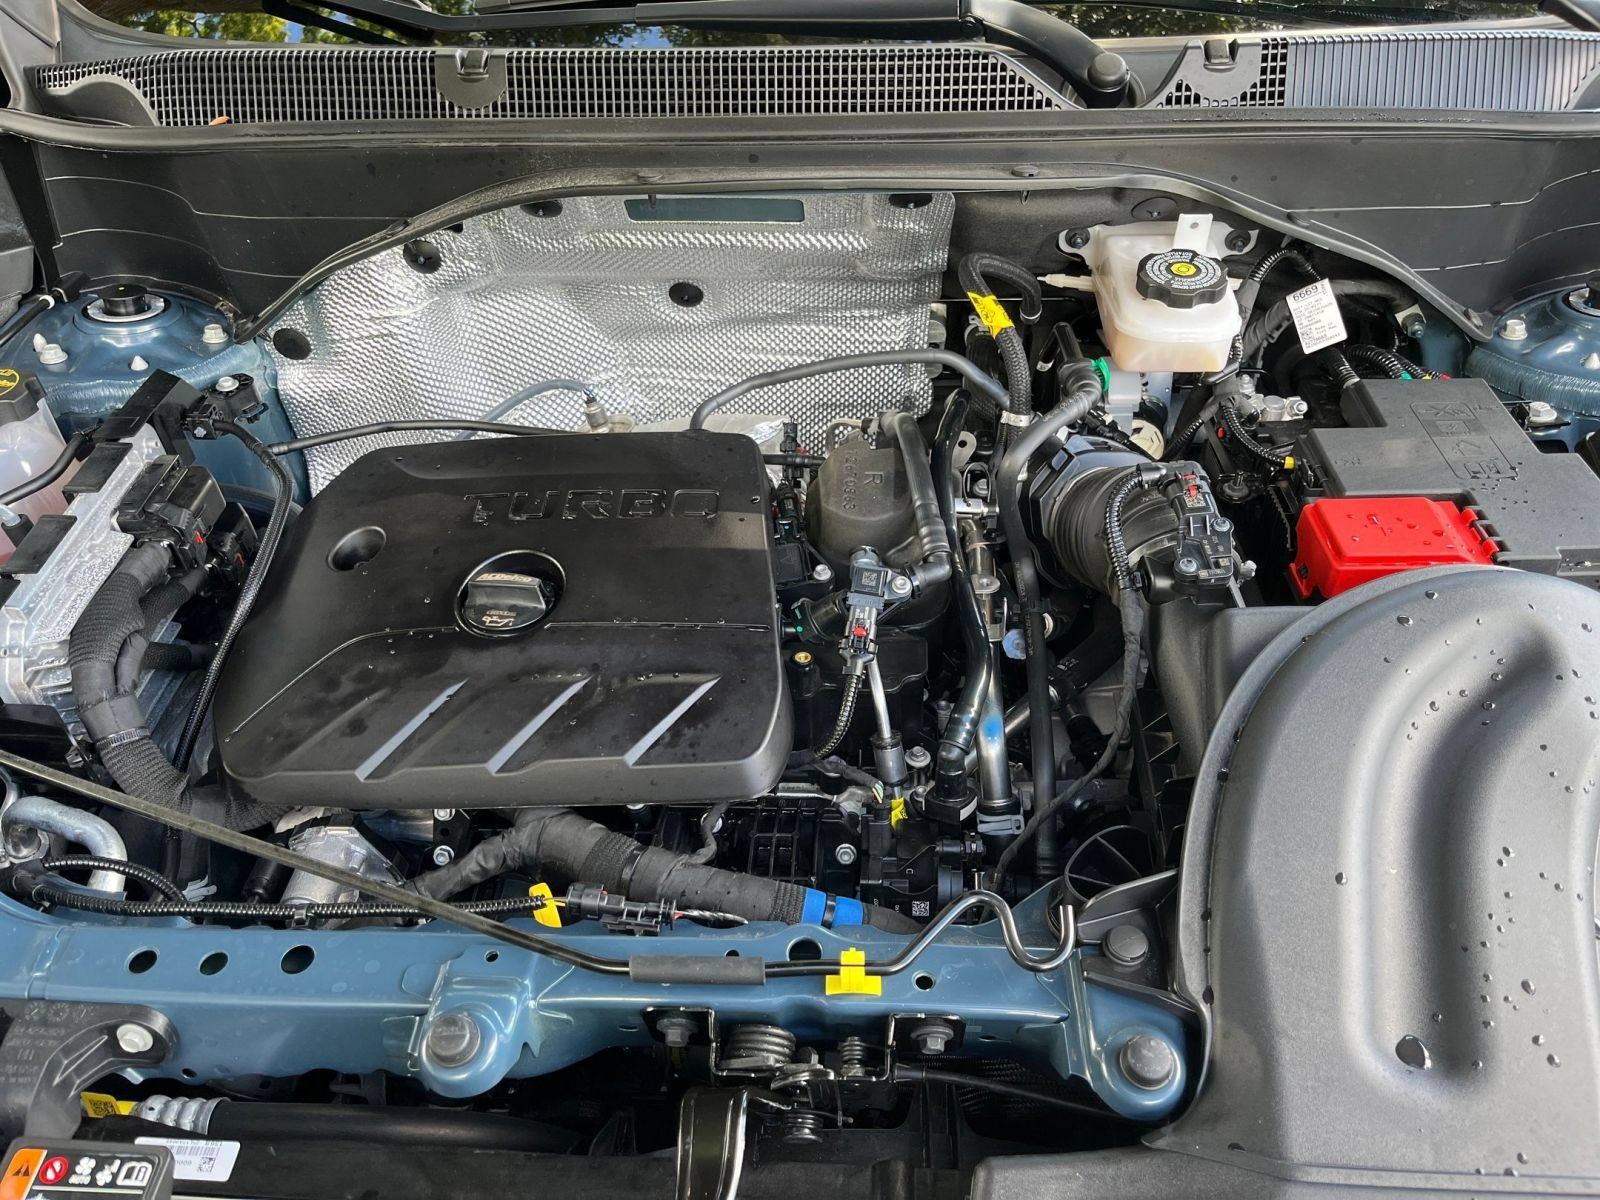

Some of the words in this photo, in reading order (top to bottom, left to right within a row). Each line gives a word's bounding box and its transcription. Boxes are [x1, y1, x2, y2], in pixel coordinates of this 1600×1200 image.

[1293, 284, 1318, 301] 6669
[464, 489, 720, 522] TURBO
[475, 573, 533, 582] ACDelco
[68, 1174, 92, 1185] AUTO
